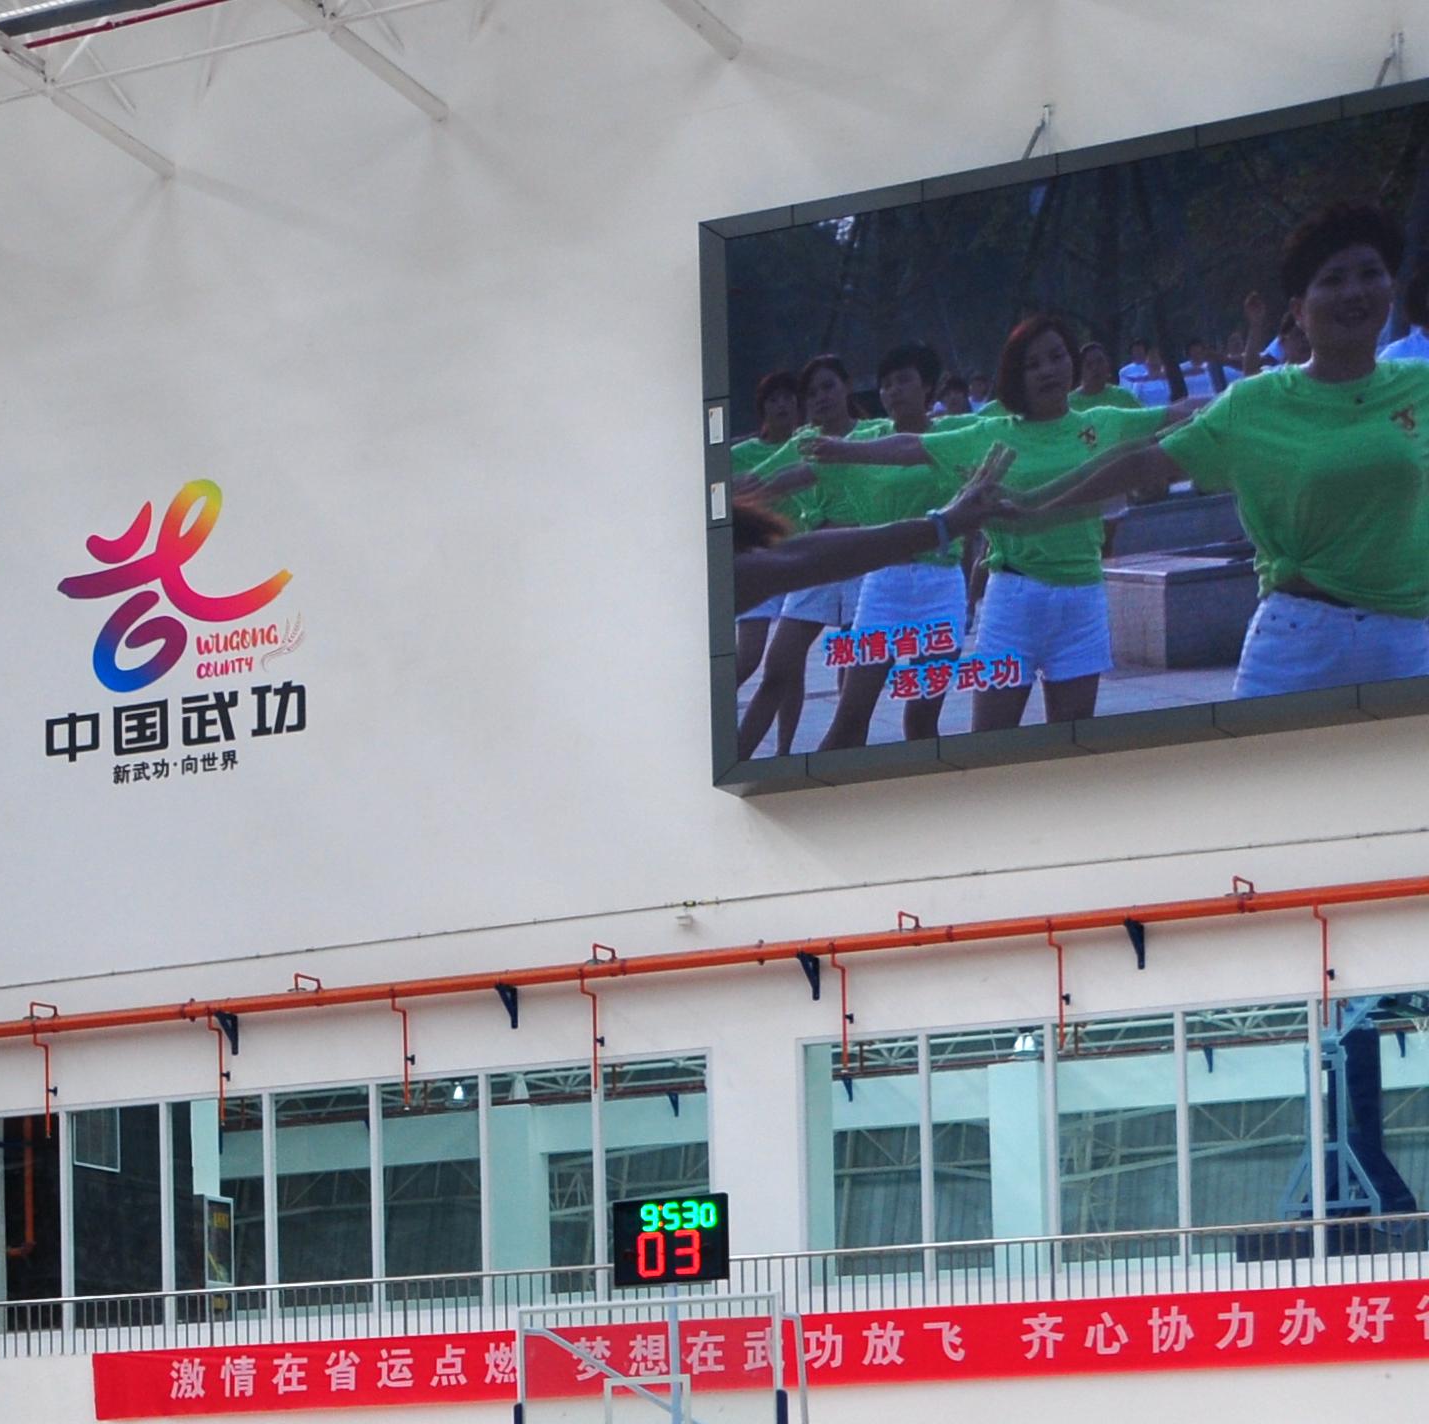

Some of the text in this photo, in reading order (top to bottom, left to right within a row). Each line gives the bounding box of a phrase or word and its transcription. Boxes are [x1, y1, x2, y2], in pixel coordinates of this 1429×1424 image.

[196, 624, 279, 656] WUGONG
[824, 622, 955, 668] 激情省运
[196, 657, 255, 680] COUNTY
[888, 654, 1021, 701] 逐梦武功
[45, 681, 307, 763] 中国武功
[112, 750, 239, 785] 新武功·向世界
[637, 1229, 701, 1278] 03
